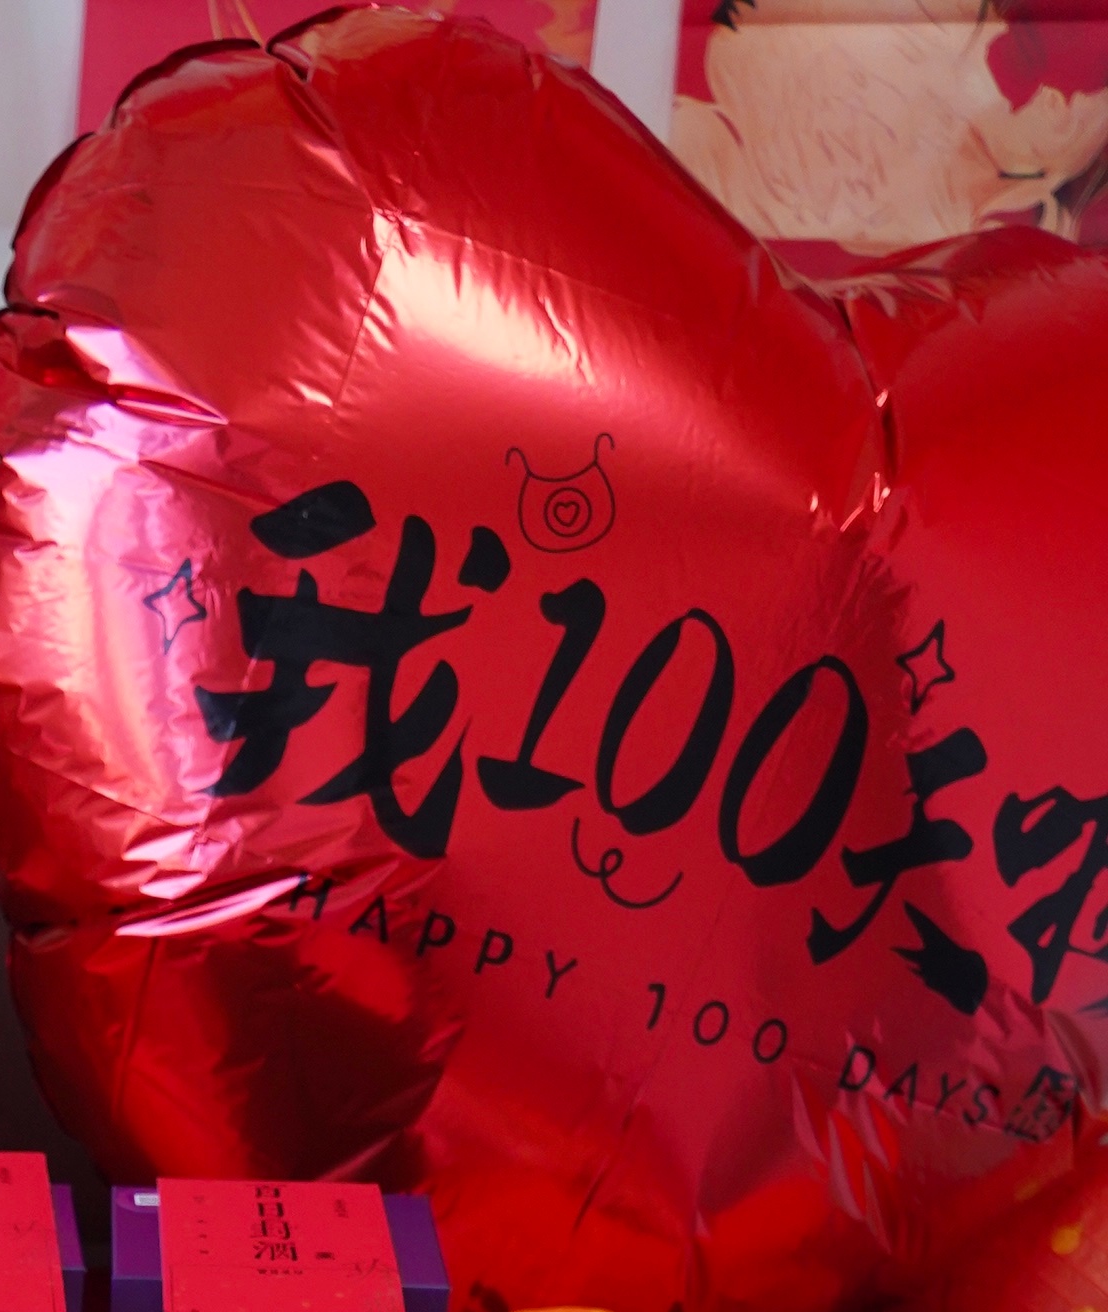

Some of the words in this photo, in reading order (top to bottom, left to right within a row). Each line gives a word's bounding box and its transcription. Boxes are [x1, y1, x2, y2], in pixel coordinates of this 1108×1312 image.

[288, 869, 578, 999] HAPPY
[646, 983, 789, 1065] 100
[838, 1045, 999, 1128] DAYS
